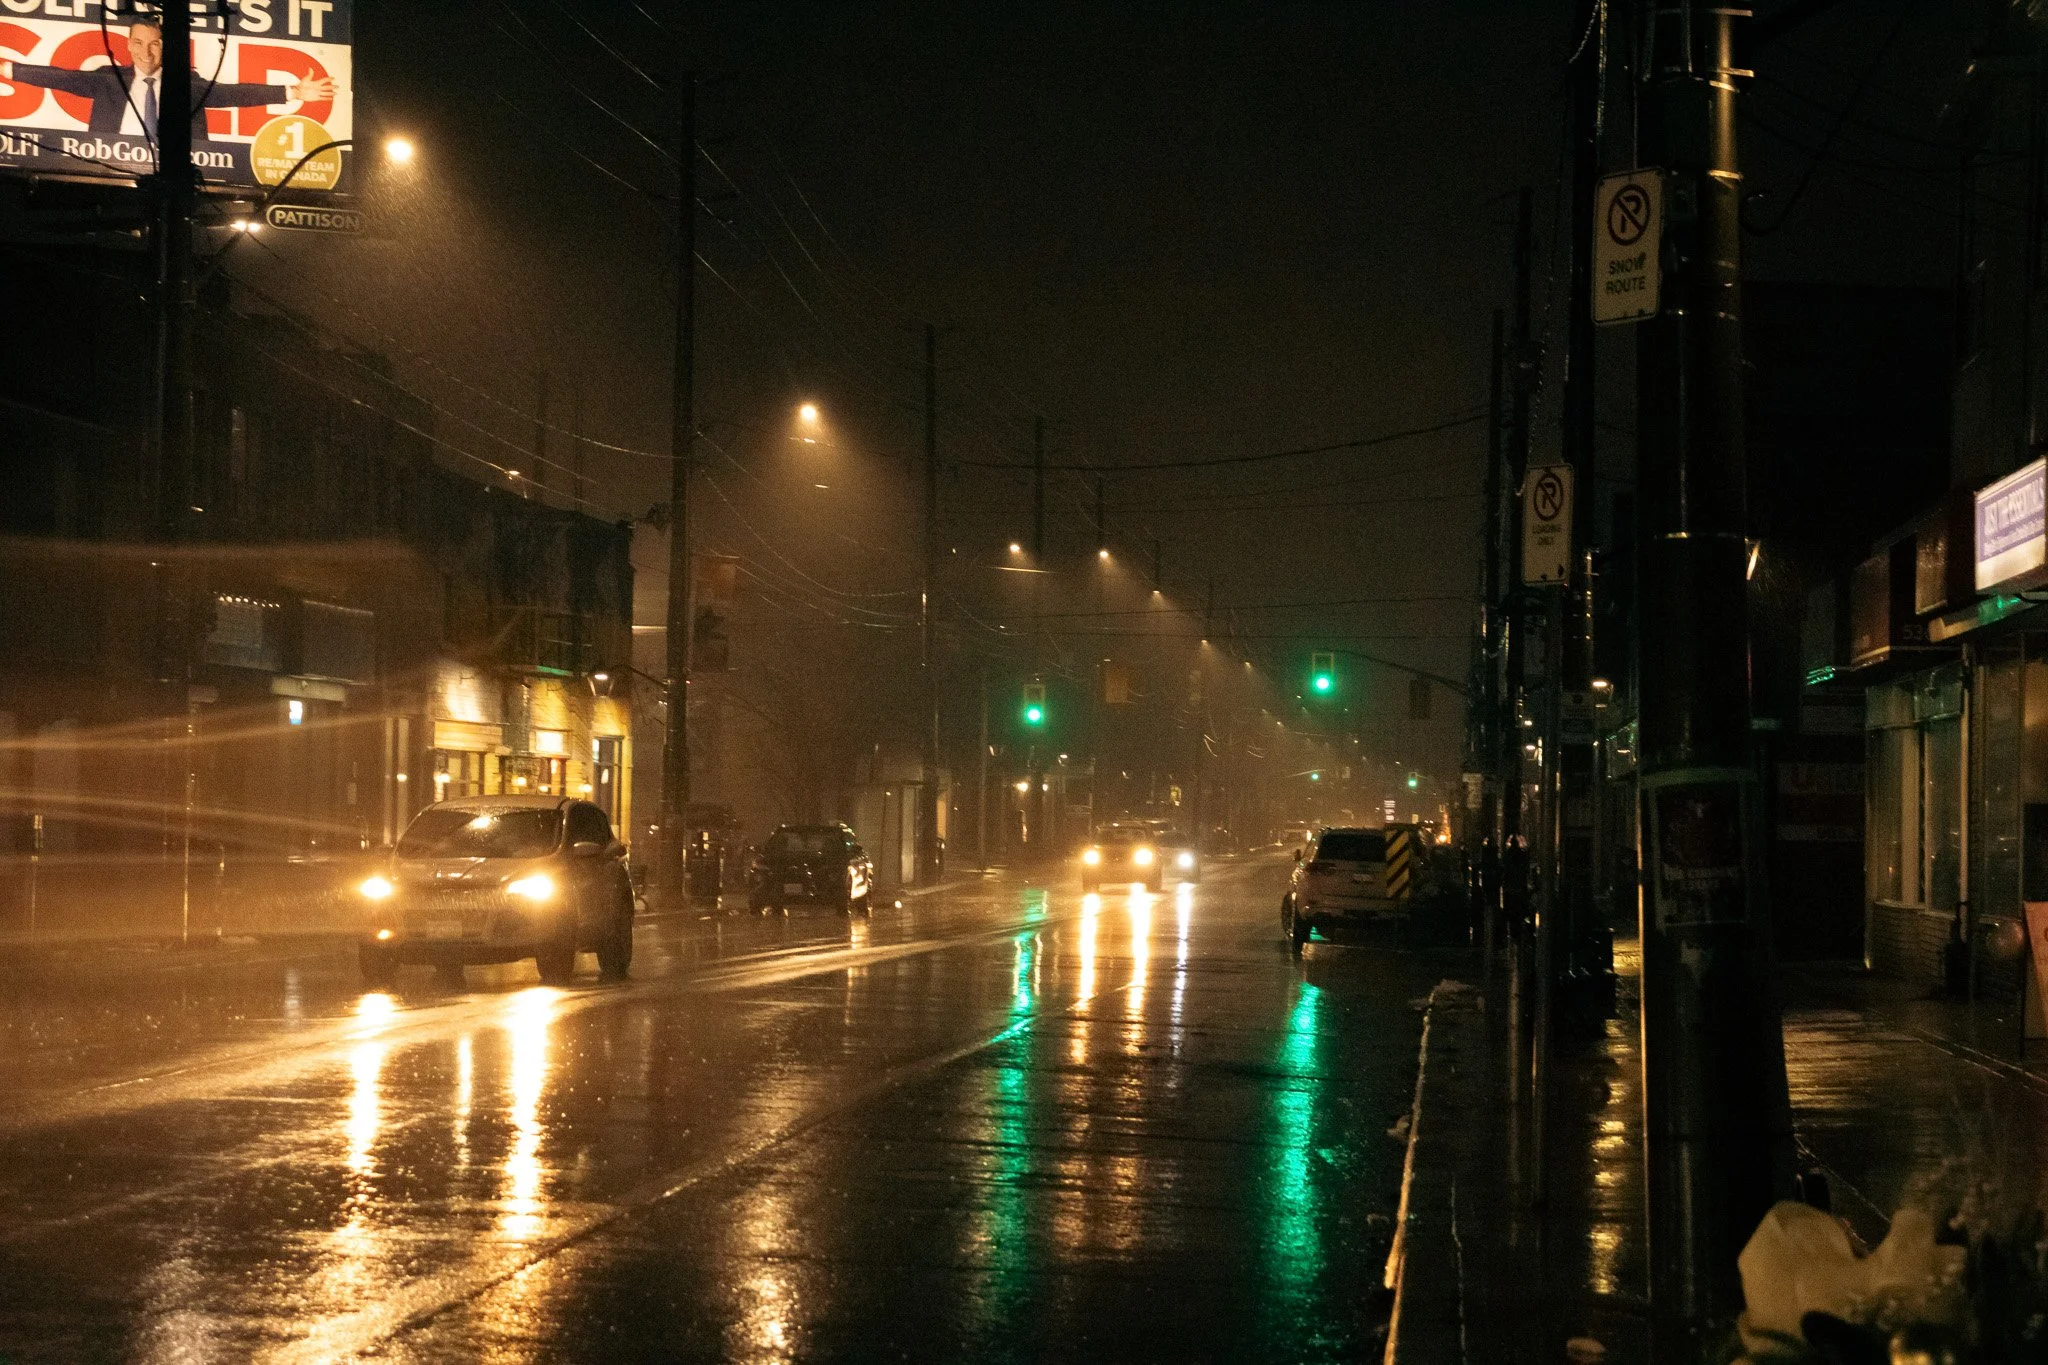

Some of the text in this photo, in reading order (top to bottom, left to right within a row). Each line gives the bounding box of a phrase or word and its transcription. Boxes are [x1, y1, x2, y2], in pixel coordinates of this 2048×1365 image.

[288, 0, 333, 38] IT
[0, 22, 334, 137] SOD
[277, 121, 309, 159] #1
[265, 169, 328, 183] IN CNADA
[304, 161, 335, 173] TEAM
[274, 210, 360, 230] PATTISON
[1608, 255, 1646, 275] SNOW
[1605, 275, 1646, 296] ROUTE
